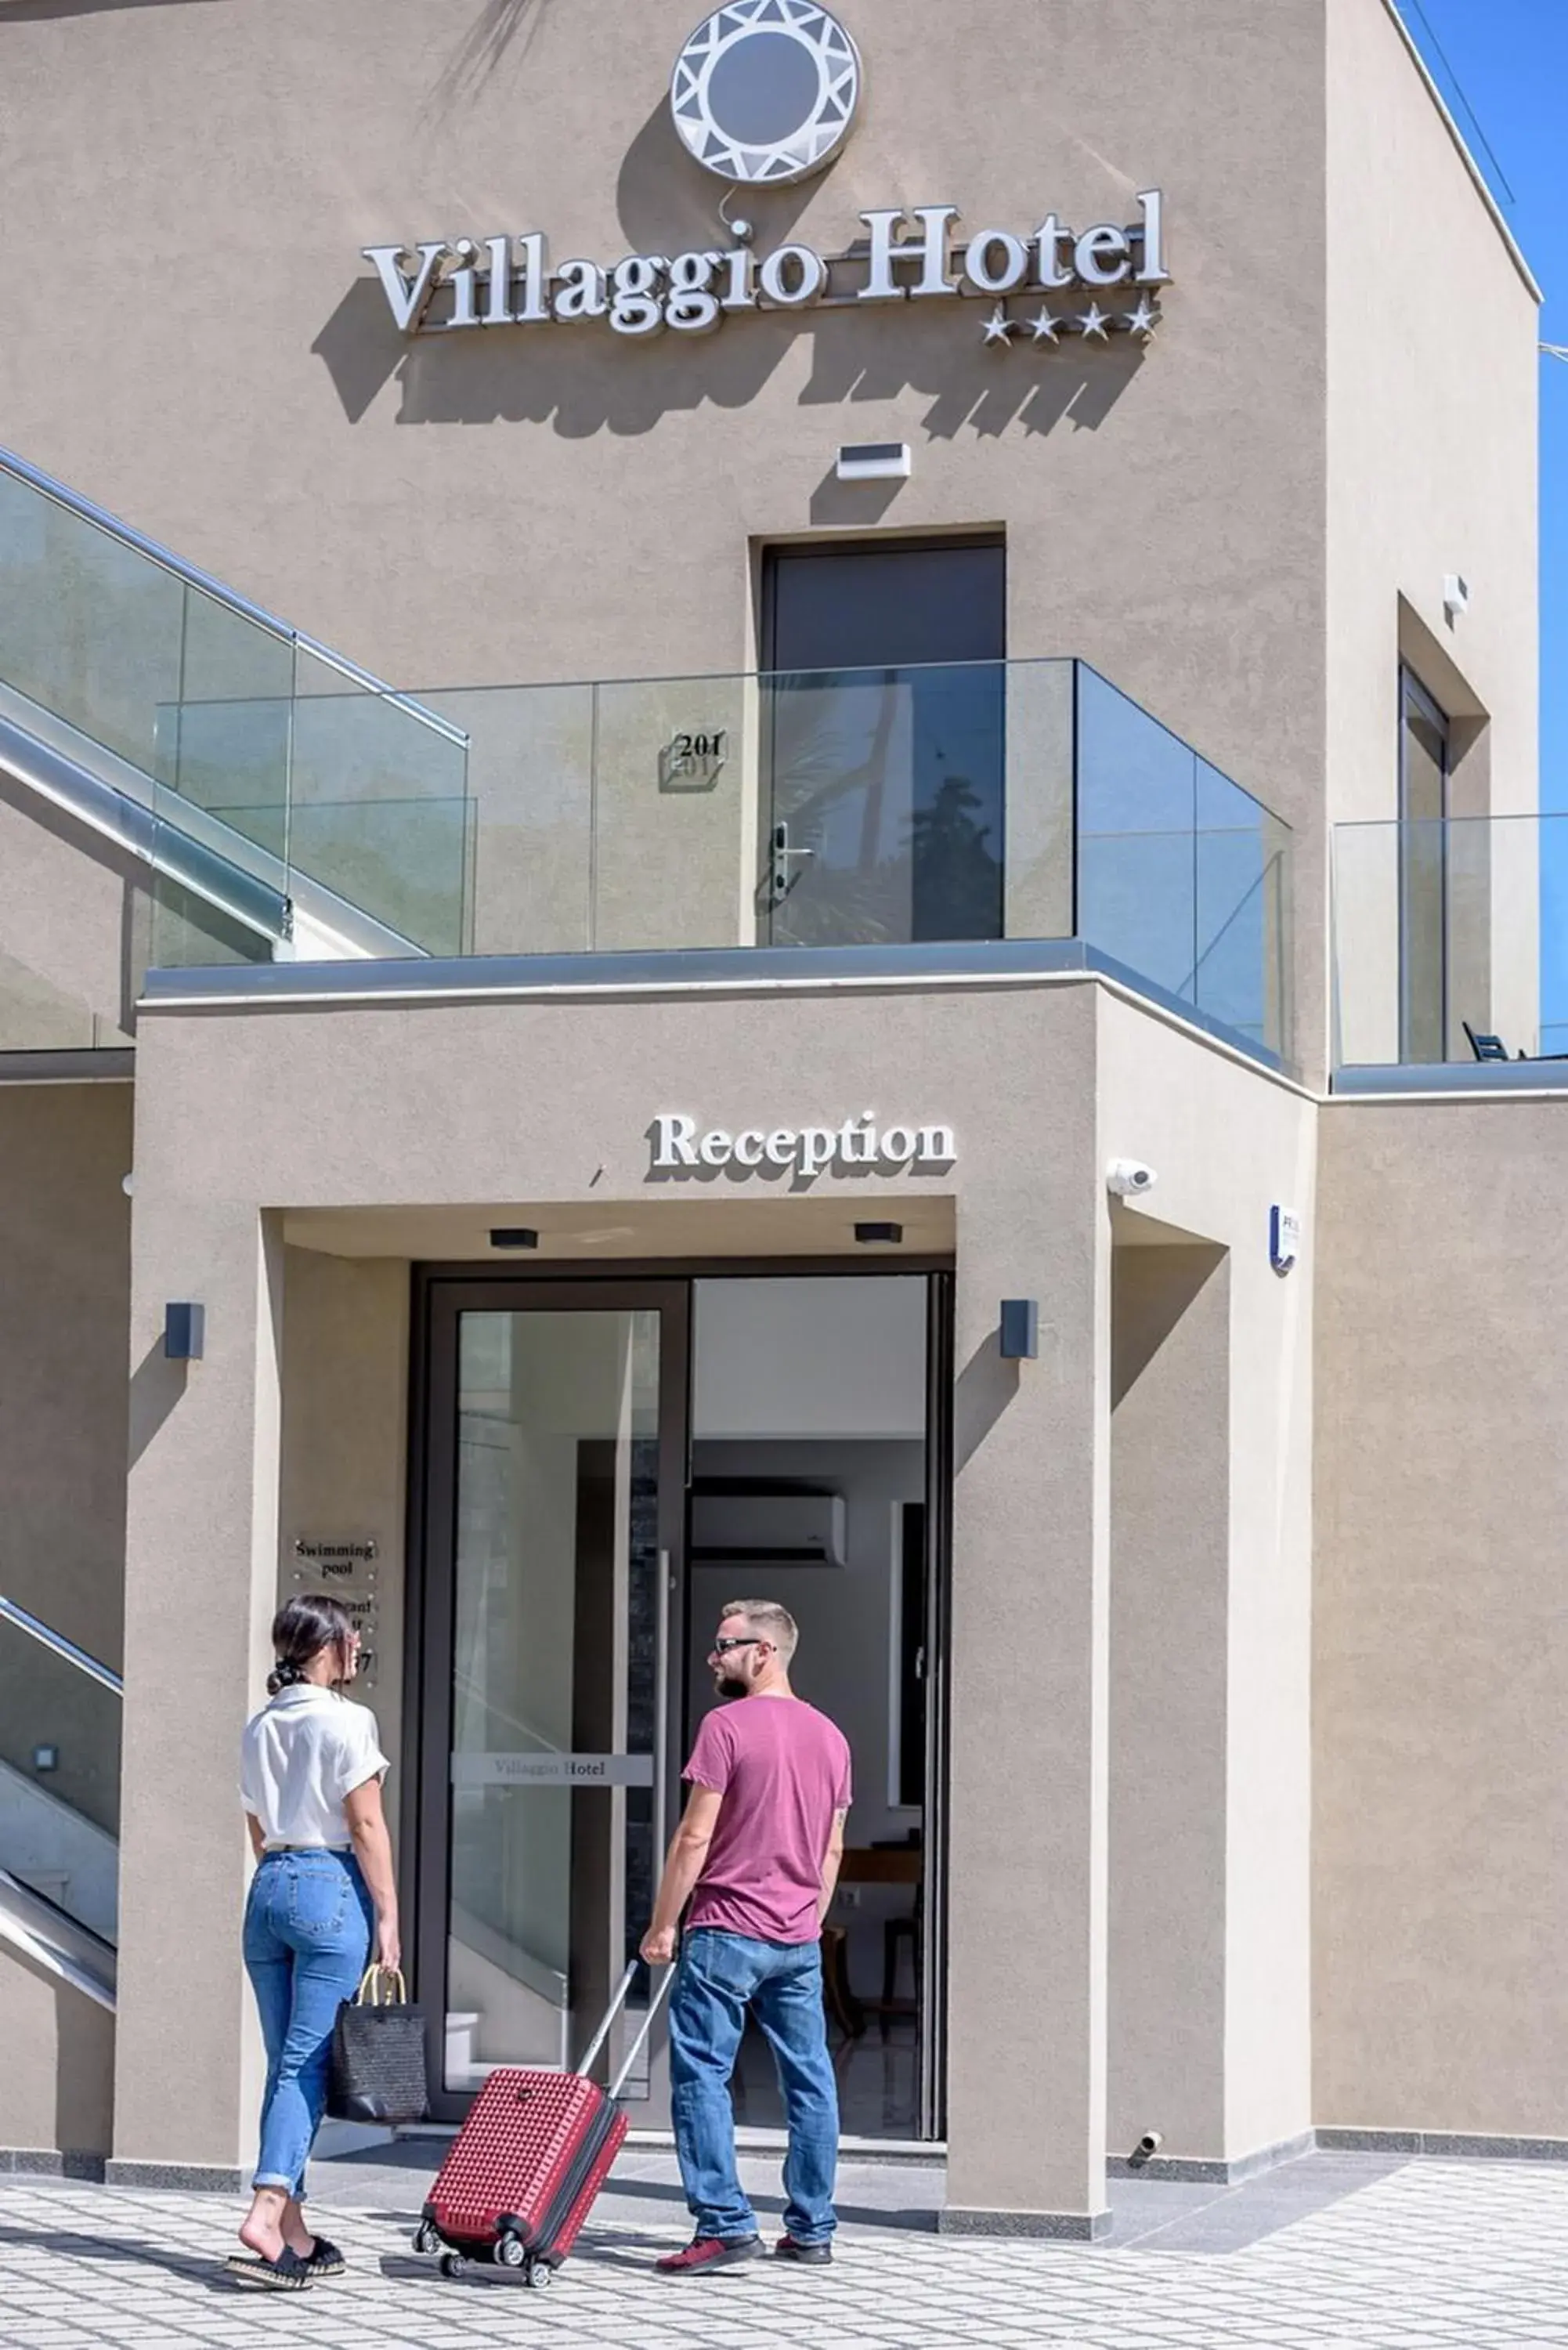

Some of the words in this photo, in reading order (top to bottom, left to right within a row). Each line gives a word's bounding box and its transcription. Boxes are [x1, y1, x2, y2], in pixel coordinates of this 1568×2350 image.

[362, 219, 828, 334] Villaggio
[858, 190, 1172, 300] Hotel
[680, 734, 720, 757] 201
[653, 1110, 957, 1175] Reception
[296, 1542, 374, 1561] Swimming
[322, 1562, 352, 1578] pool
[563, 1761, 605, 1776] Hotel
